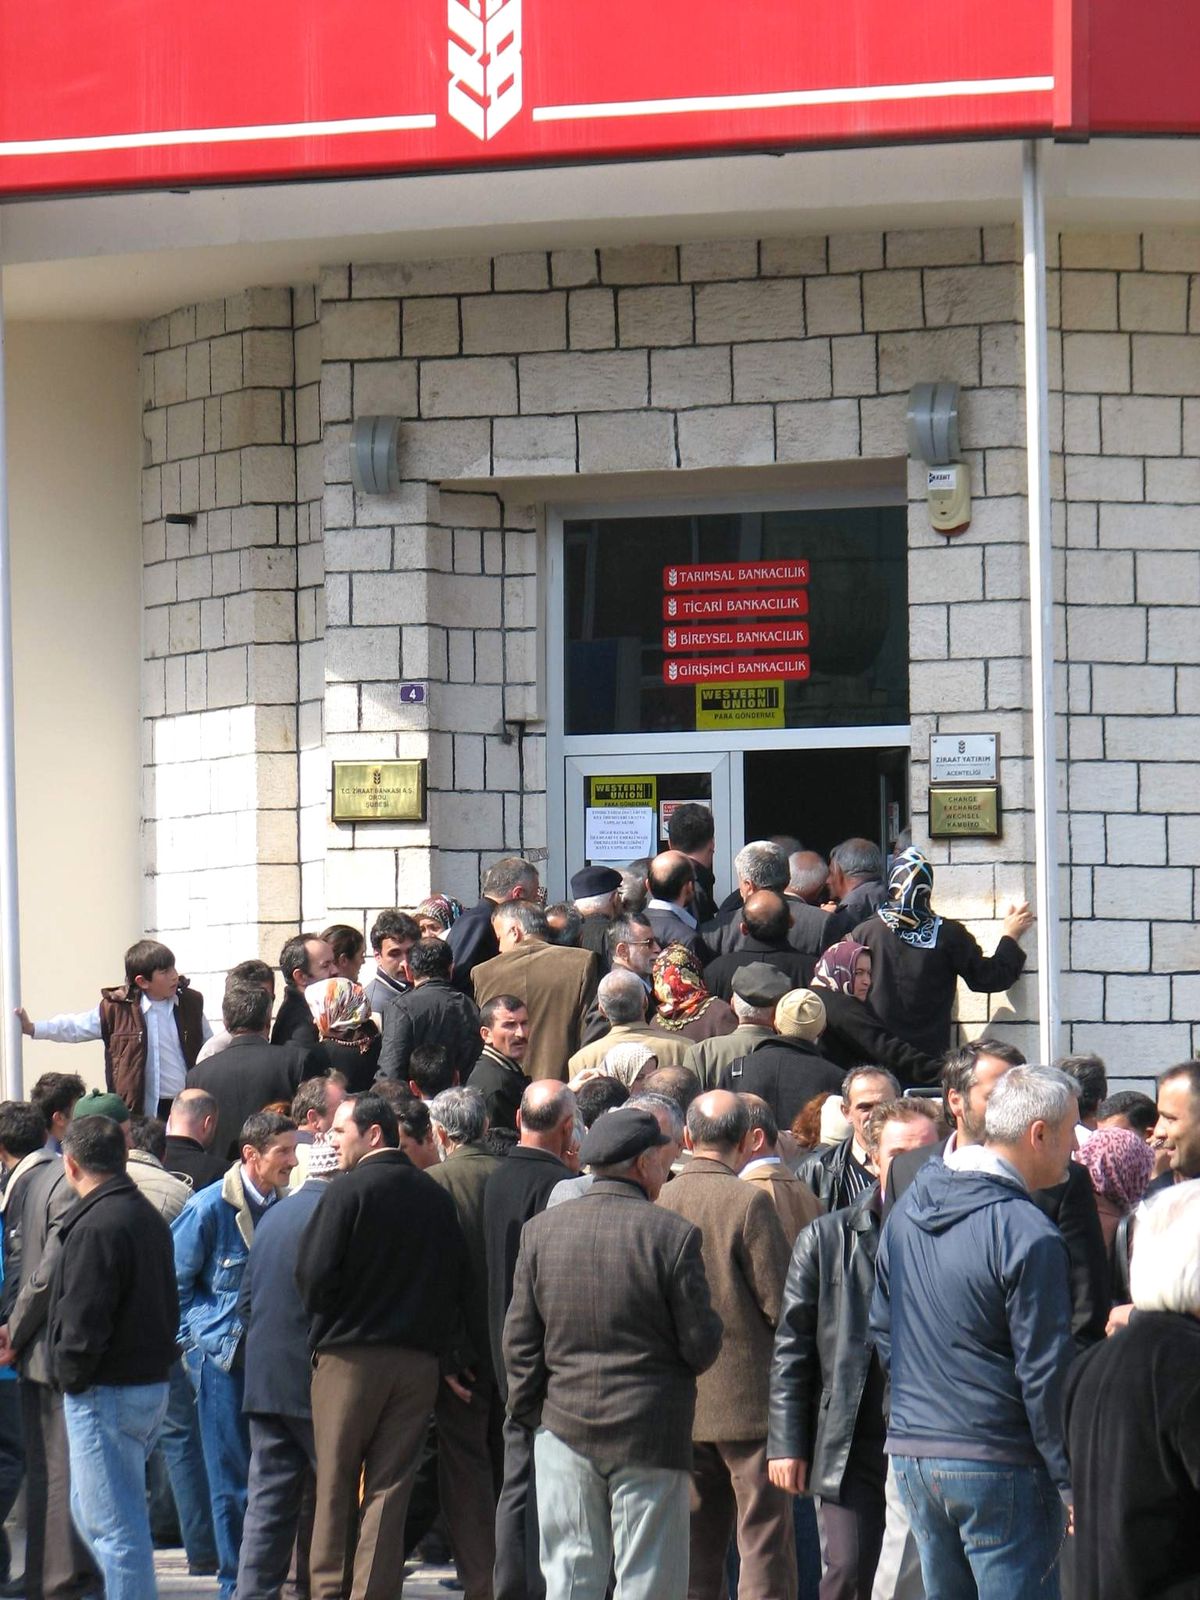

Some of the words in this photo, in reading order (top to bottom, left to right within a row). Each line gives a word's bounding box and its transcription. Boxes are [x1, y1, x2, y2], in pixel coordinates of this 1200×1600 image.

[679, 570, 735, 582] TARIMSAL
[738, 566, 806, 580] BANKACILIK
[683, 599, 723, 613] TİCARİ
[727, 597, 799, 611] BANKACILIK
[680, 632, 733, 645] BİREYSEL
[736, 630, 804, 643] BANKACILIK
[679, 662, 734, 677] GİRİŞİMCİ
[738, 660, 806, 674] BANKACILIK
[409, 688, 417, 699] 4
[702, 688, 766, 700] WESTERN
[722, 699, 766, 709] UNION
[714, 712, 733, 720] PARA
[596, 783, 643, 792] WESTERN
[610, 791, 643, 799] UNION
